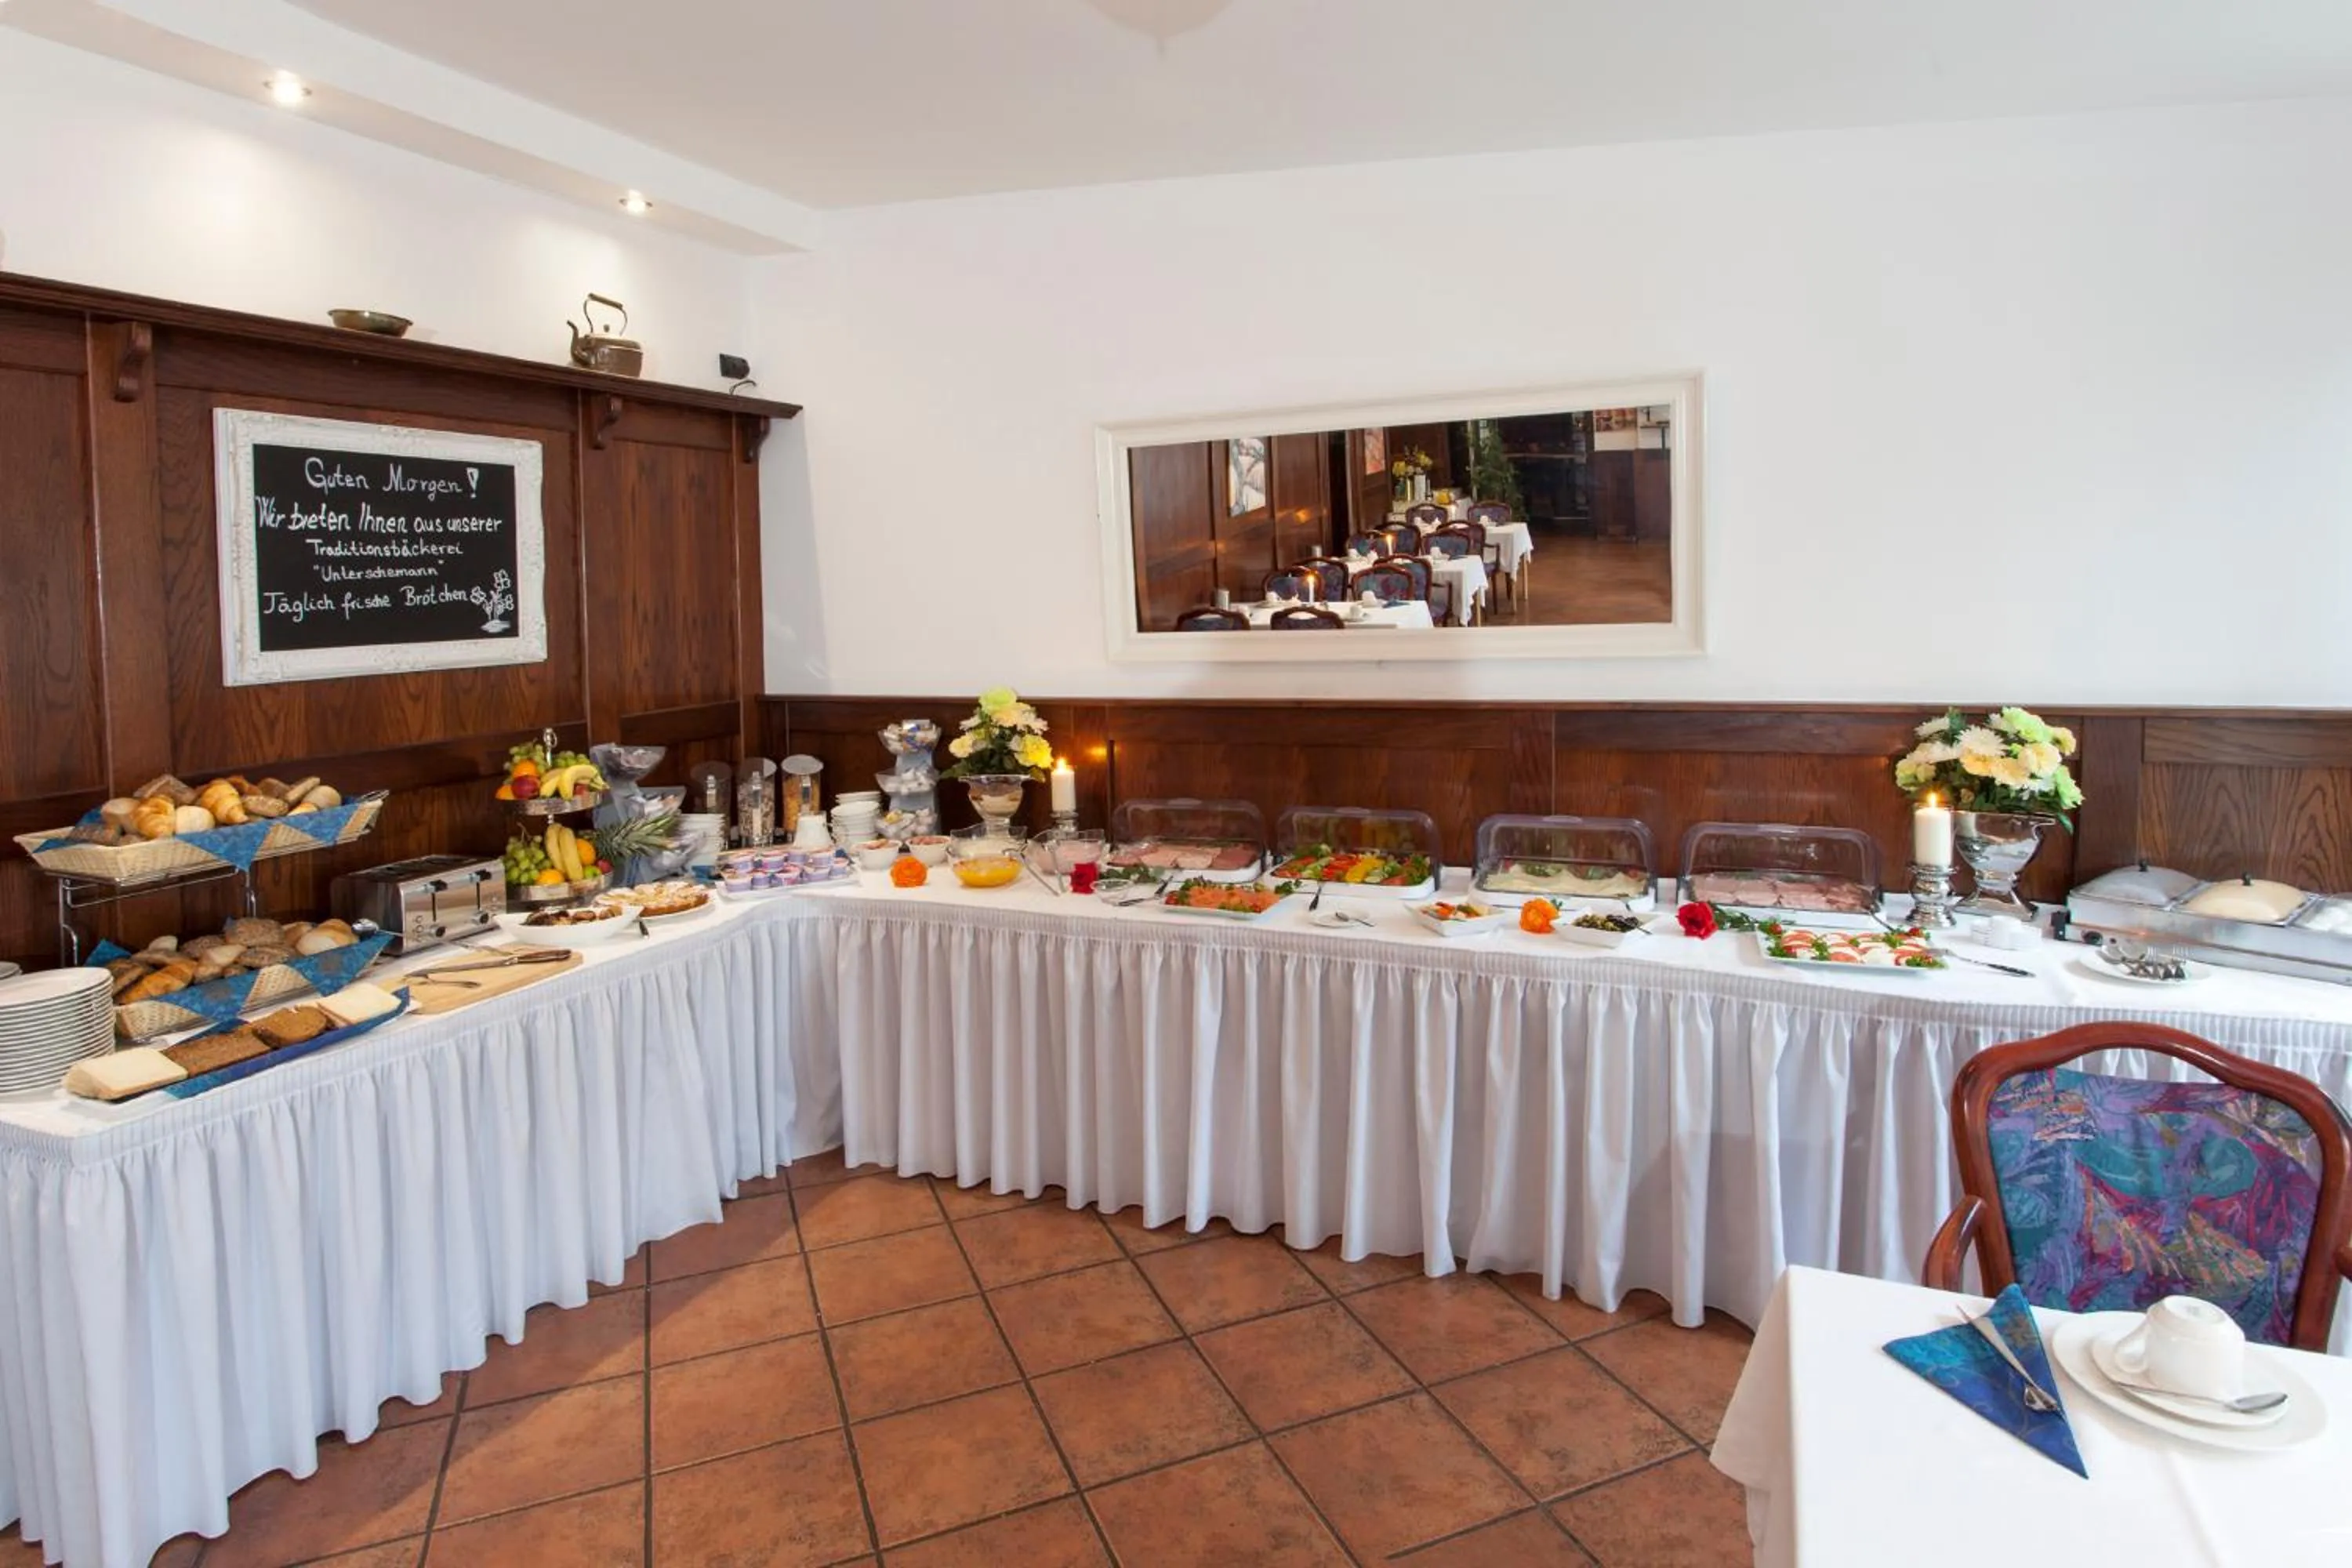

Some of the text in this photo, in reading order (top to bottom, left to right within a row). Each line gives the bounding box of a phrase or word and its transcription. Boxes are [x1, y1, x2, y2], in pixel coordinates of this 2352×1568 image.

[305, 457, 369, 495] Guten
[255, 495, 502, 533] Wir bieten Ihnen aus unserer
[305, 538, 463, 557] Traditionsbäckerei
[342, 591, 391, 620] frische
[399, 583, 468, 607] Brötchen
